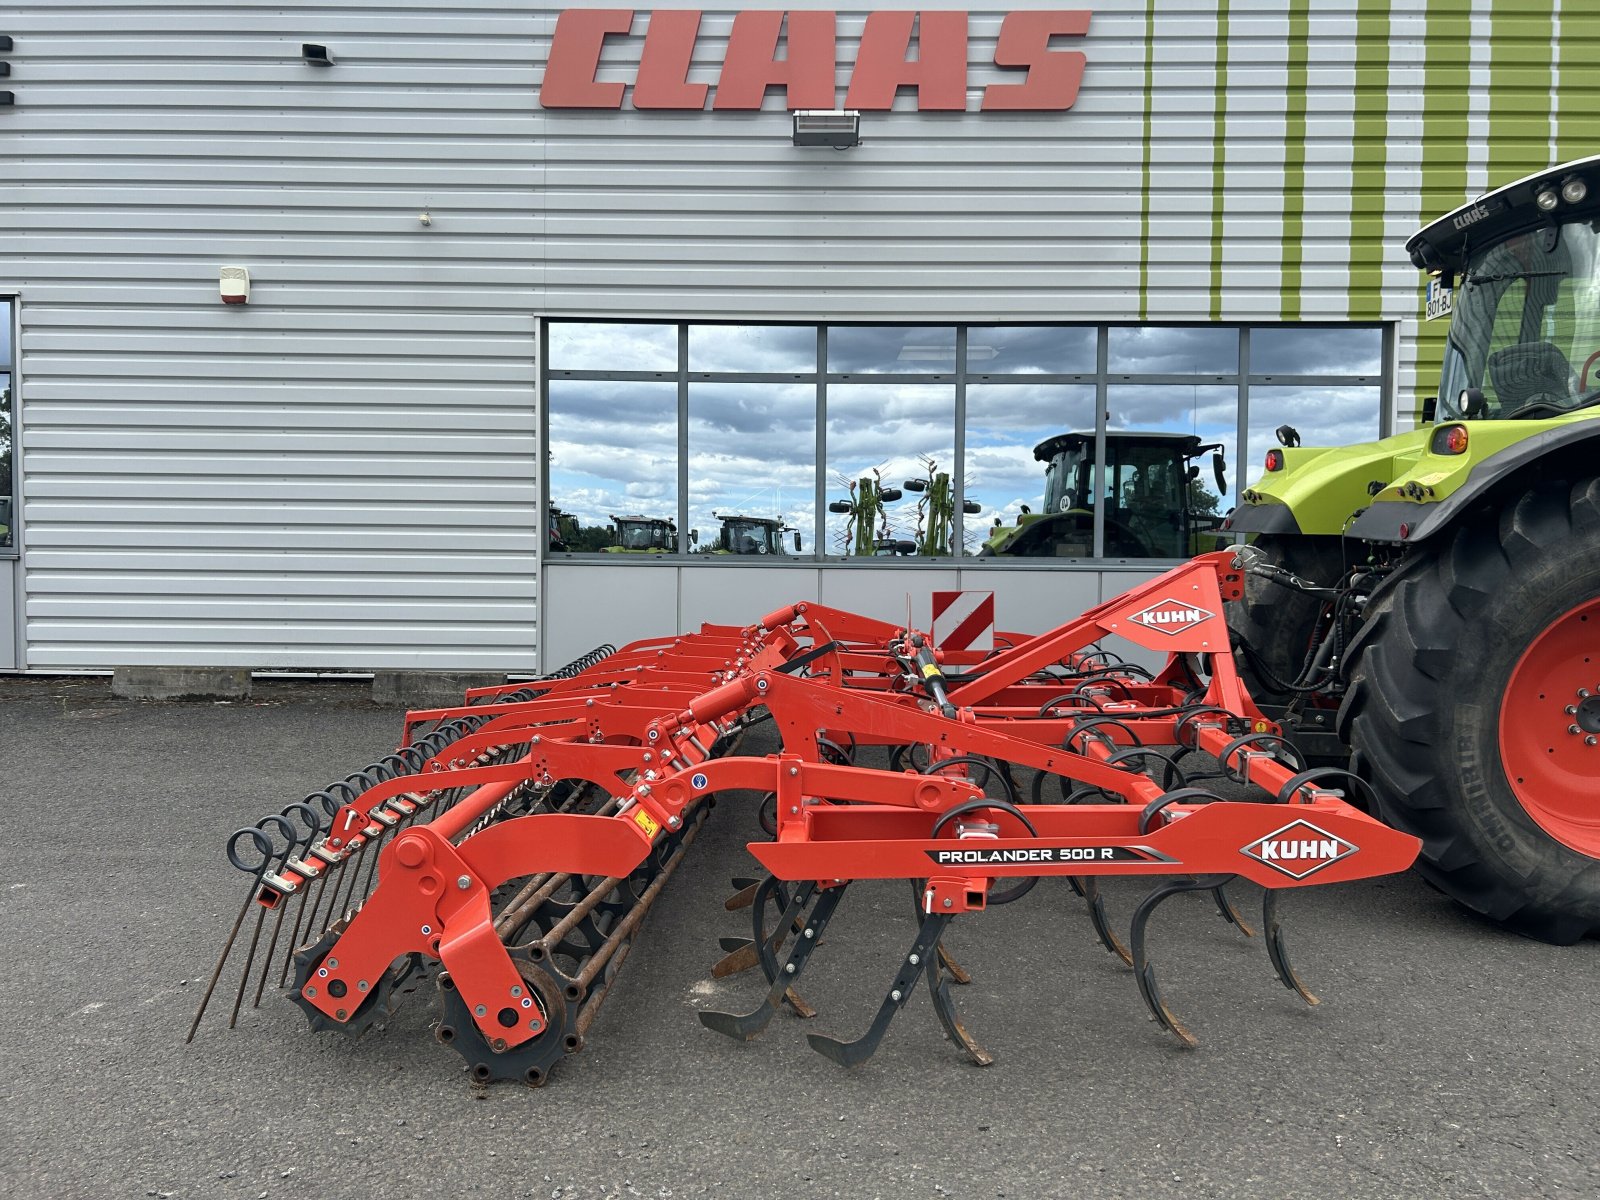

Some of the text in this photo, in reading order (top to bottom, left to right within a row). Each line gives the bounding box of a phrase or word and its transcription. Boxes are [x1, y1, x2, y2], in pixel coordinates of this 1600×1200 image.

[540, 9, 1093, 111] CLAAS
[1453, 204, 1490, 230] CLAAS
[1142, 610, 1200, 624] KUHN
[939, 848, 1114, 863] PROLANDER 500 R
[1261, 840, 1338, 859] KUHN
